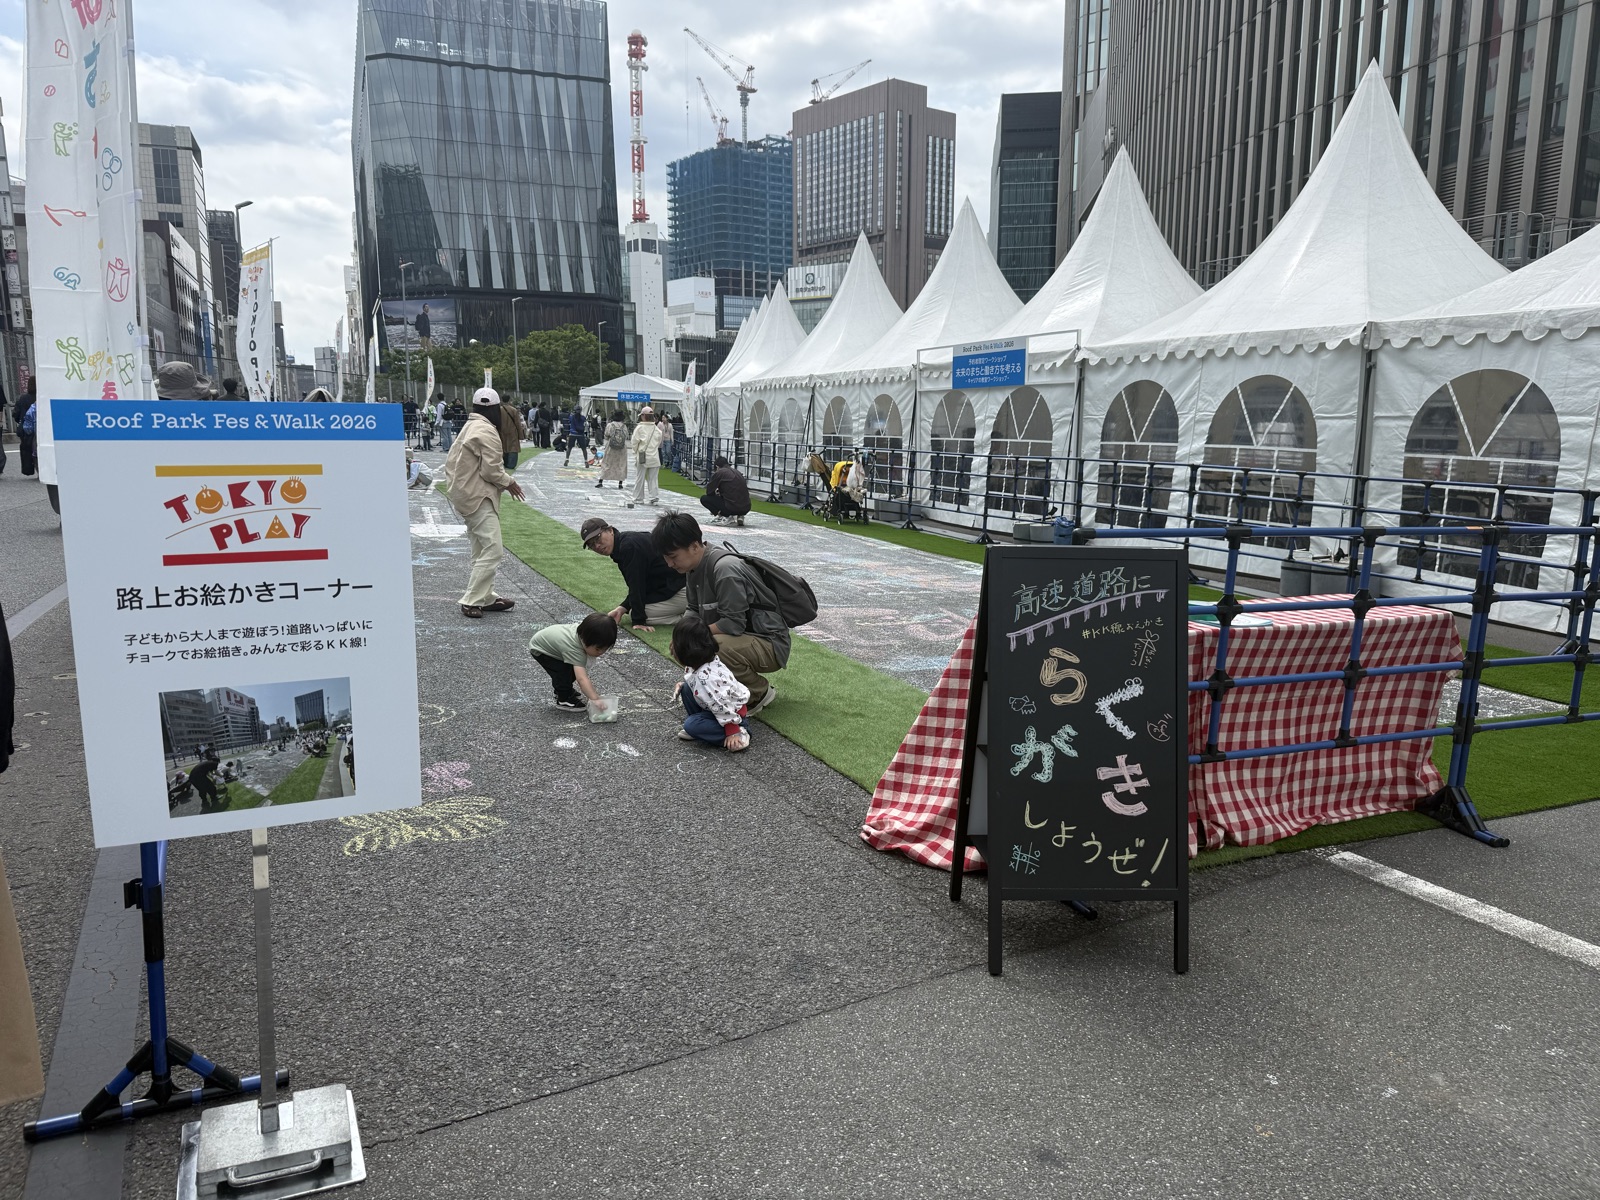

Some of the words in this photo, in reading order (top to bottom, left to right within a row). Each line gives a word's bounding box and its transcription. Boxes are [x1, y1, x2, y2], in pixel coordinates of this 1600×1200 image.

[955, 363, 1021, 378] 未来のまちと働き方を考える
[85, 412, 143, 429] Roof
[151, 413, 207, 429] Park
[214, 413, 249, 429] Fes
[270, 413, 326, 430] Walk
[330, 414, 377, 430] 2026
[163, 476, 307, 524] TOKYO
[209, 512, 311, 551] PLAY
[115, 578, 374, 611] 路上お絵かきコーナー
[1012, 566, 1151, 623] 高速道路に
